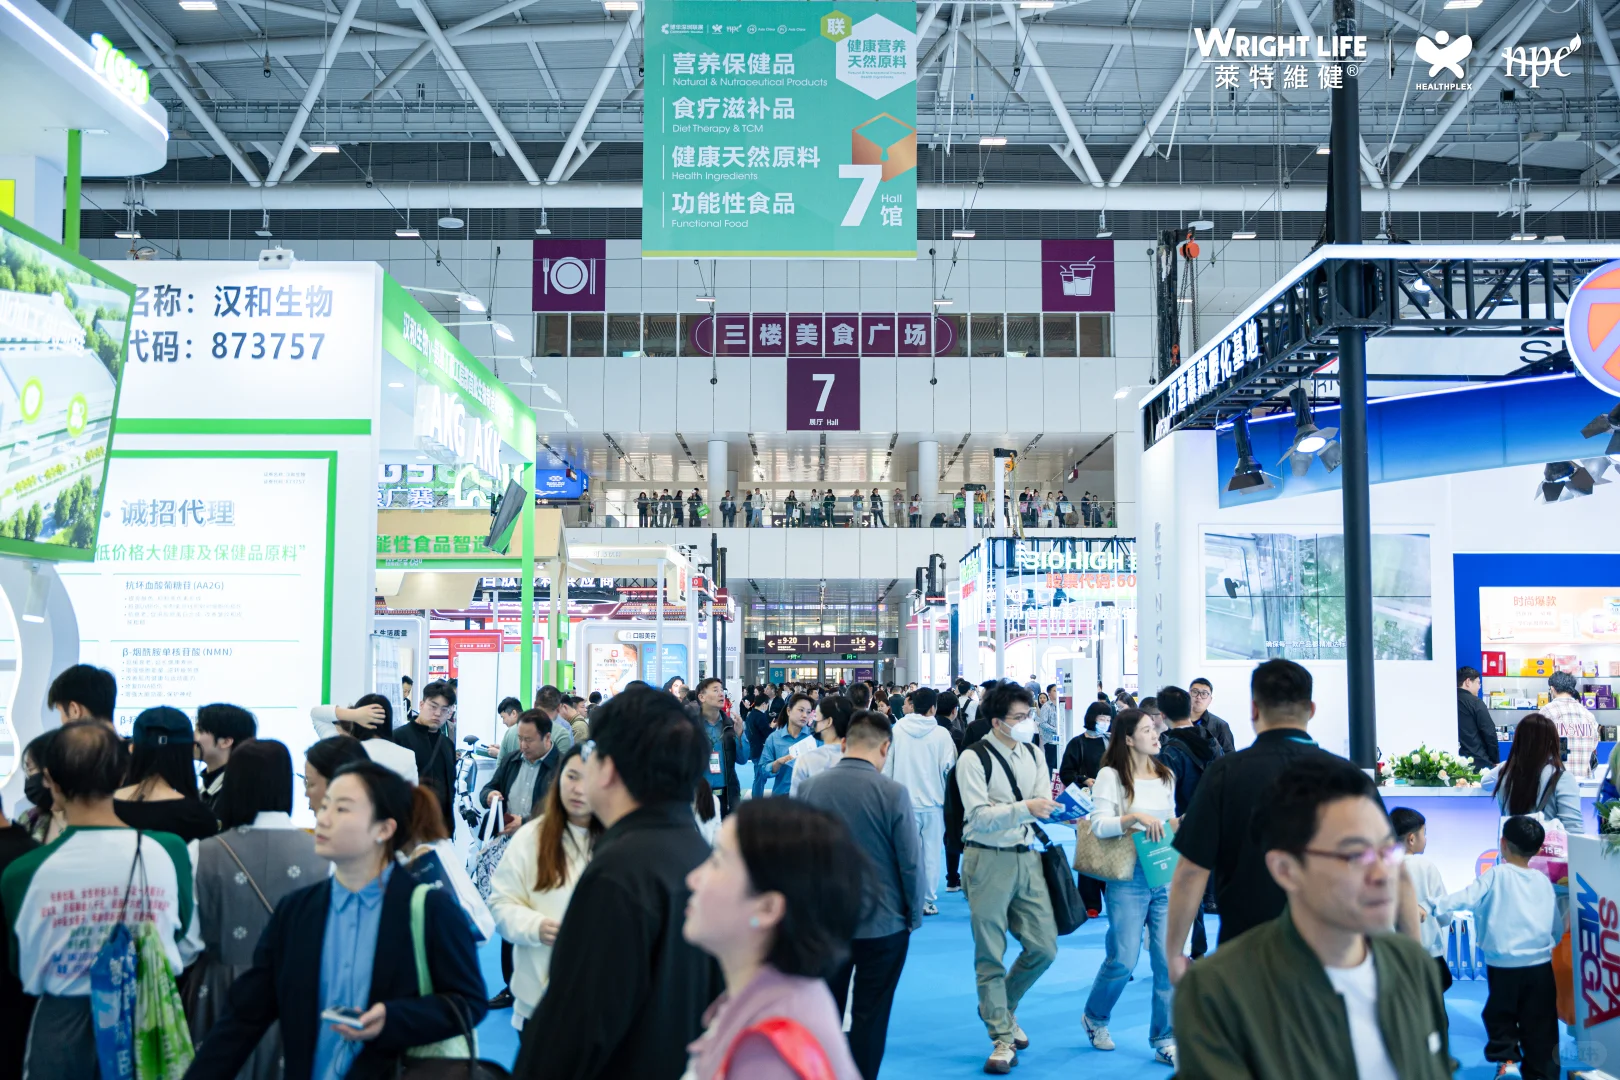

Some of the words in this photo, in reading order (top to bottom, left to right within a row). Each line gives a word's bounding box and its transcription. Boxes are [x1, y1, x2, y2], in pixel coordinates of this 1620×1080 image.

[827, 18, 845, 36] 联
[847, 39, 907, 53] 健康营养
[673, 53, 795, 75] 营养保健品
[847, 55, 907, 68] 天然原料
[673, 77, 708, 87] Natural
[710, 77, 718, 87] &
[720, 77, 785, 87] Nutraceutical
[786, 77, 828, 87] Products
[672, 97, 795, 119] 食疗滋补品
[672, 124, 691, 133] Diet
[692, 124, 731, 135] Therapy
[733, 124, 740, 133] &
[742, 124, 764, 133] TCM
[672, 146, 820, 168] 健康天然原料
[672, 171, 703, 181] Health
[705, 171, 758, 182] Ingredients
[672, 192, 795, 215] 功能性食品
[838, 164, 883, 227] 7
[881, 194, 903, 203] Hall
[672, 219, 722, 228] Functional
[724, 219, 749, 228] Food
[880, 205, 903, 227] 馆
[723, 322, 926, 347] 三楼美食广场
[1168, 317, 1259, 418] 打造爆款孵化基地
[811, 373, 836, 412] 7
[809, 418, 824, 426] 展厅
[826, 418, 839, 426] Hall
[120, 499, 235, 527] 诚招代理
[1513, 595, 1557, 607] 时尚爆款
[1575, 871, 1602, 1029] MEGA
